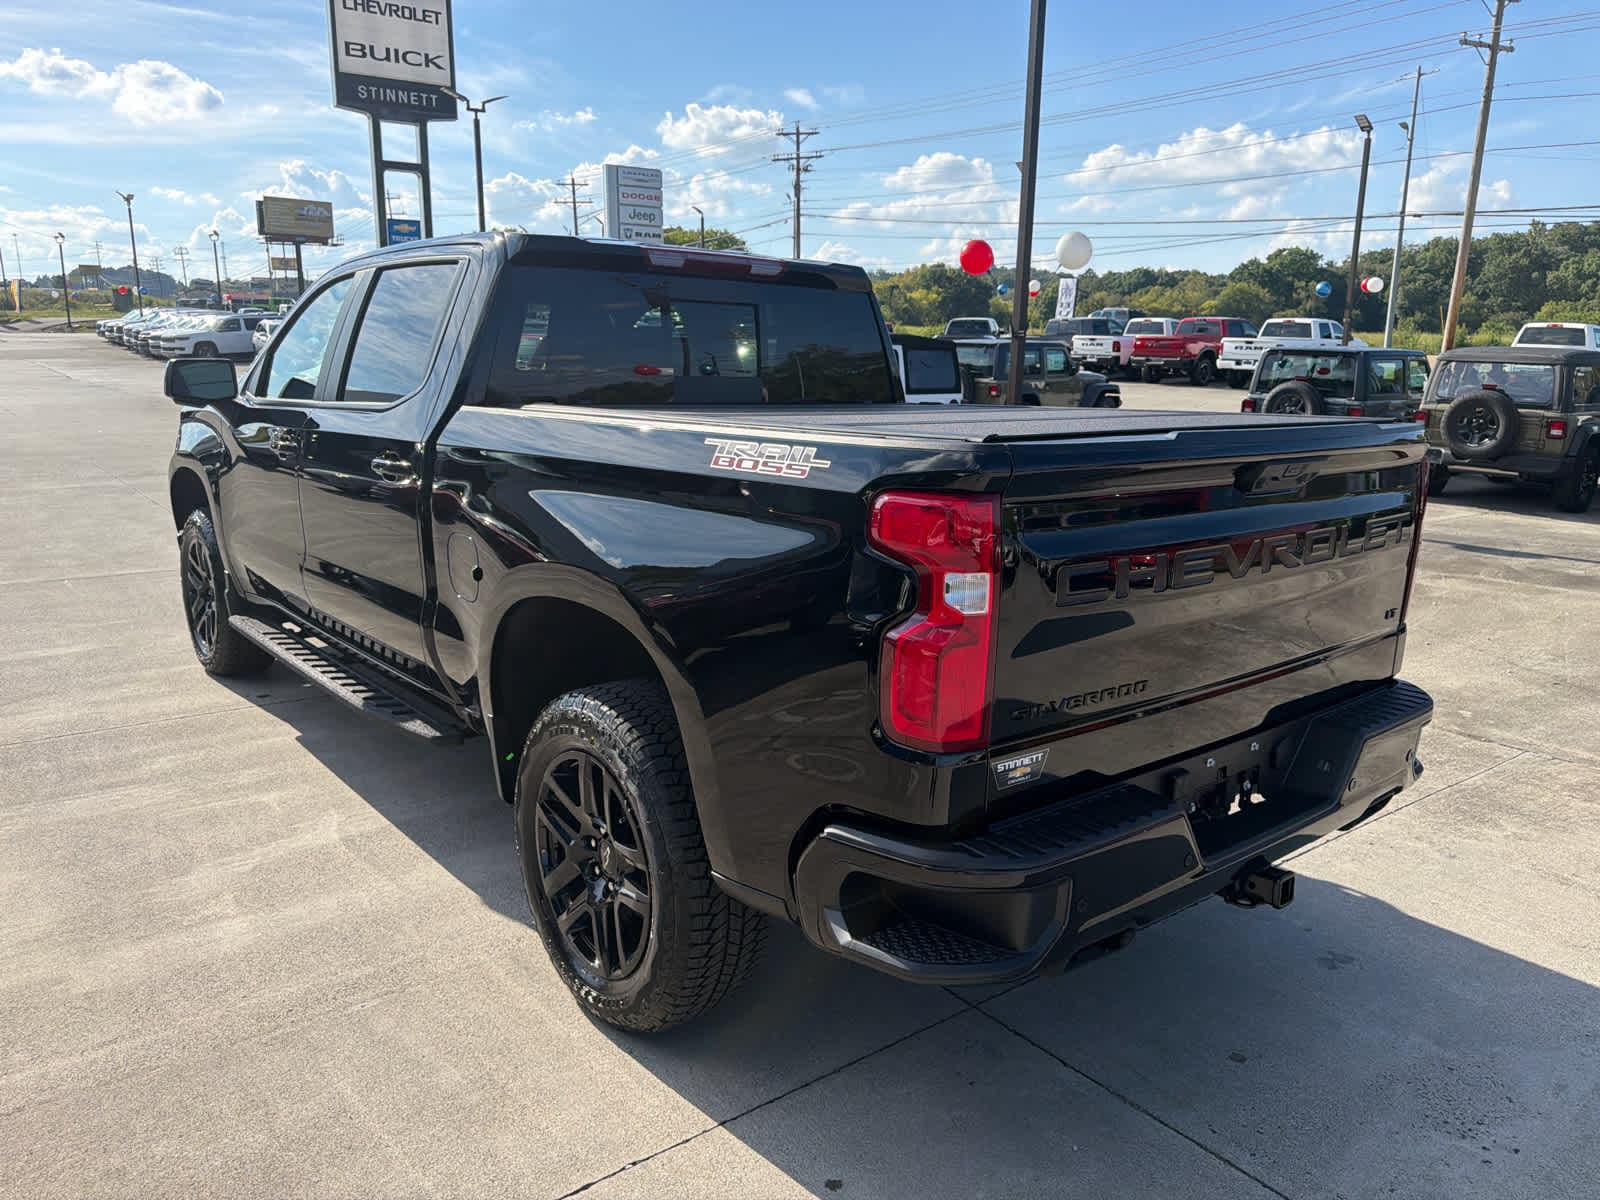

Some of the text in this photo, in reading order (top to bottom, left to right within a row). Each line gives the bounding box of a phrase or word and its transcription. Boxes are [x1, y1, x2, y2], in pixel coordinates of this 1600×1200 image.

[342, 0, 442, 25] CHEVROLET
[344, 41, 446, 70] BUICK
[357, 85, 438, 107] STINNETT
[628, 208, 656, 223] Jeep
[703, 437, 832, 468] TRAIL
[710, 454, 812, 479] BOSS
[1055, 511, 1413, 607] CHEVROLET
[1009, 679, 1149, 721] SILVERADO
[997, 752, 1044, 773] STINNETT
